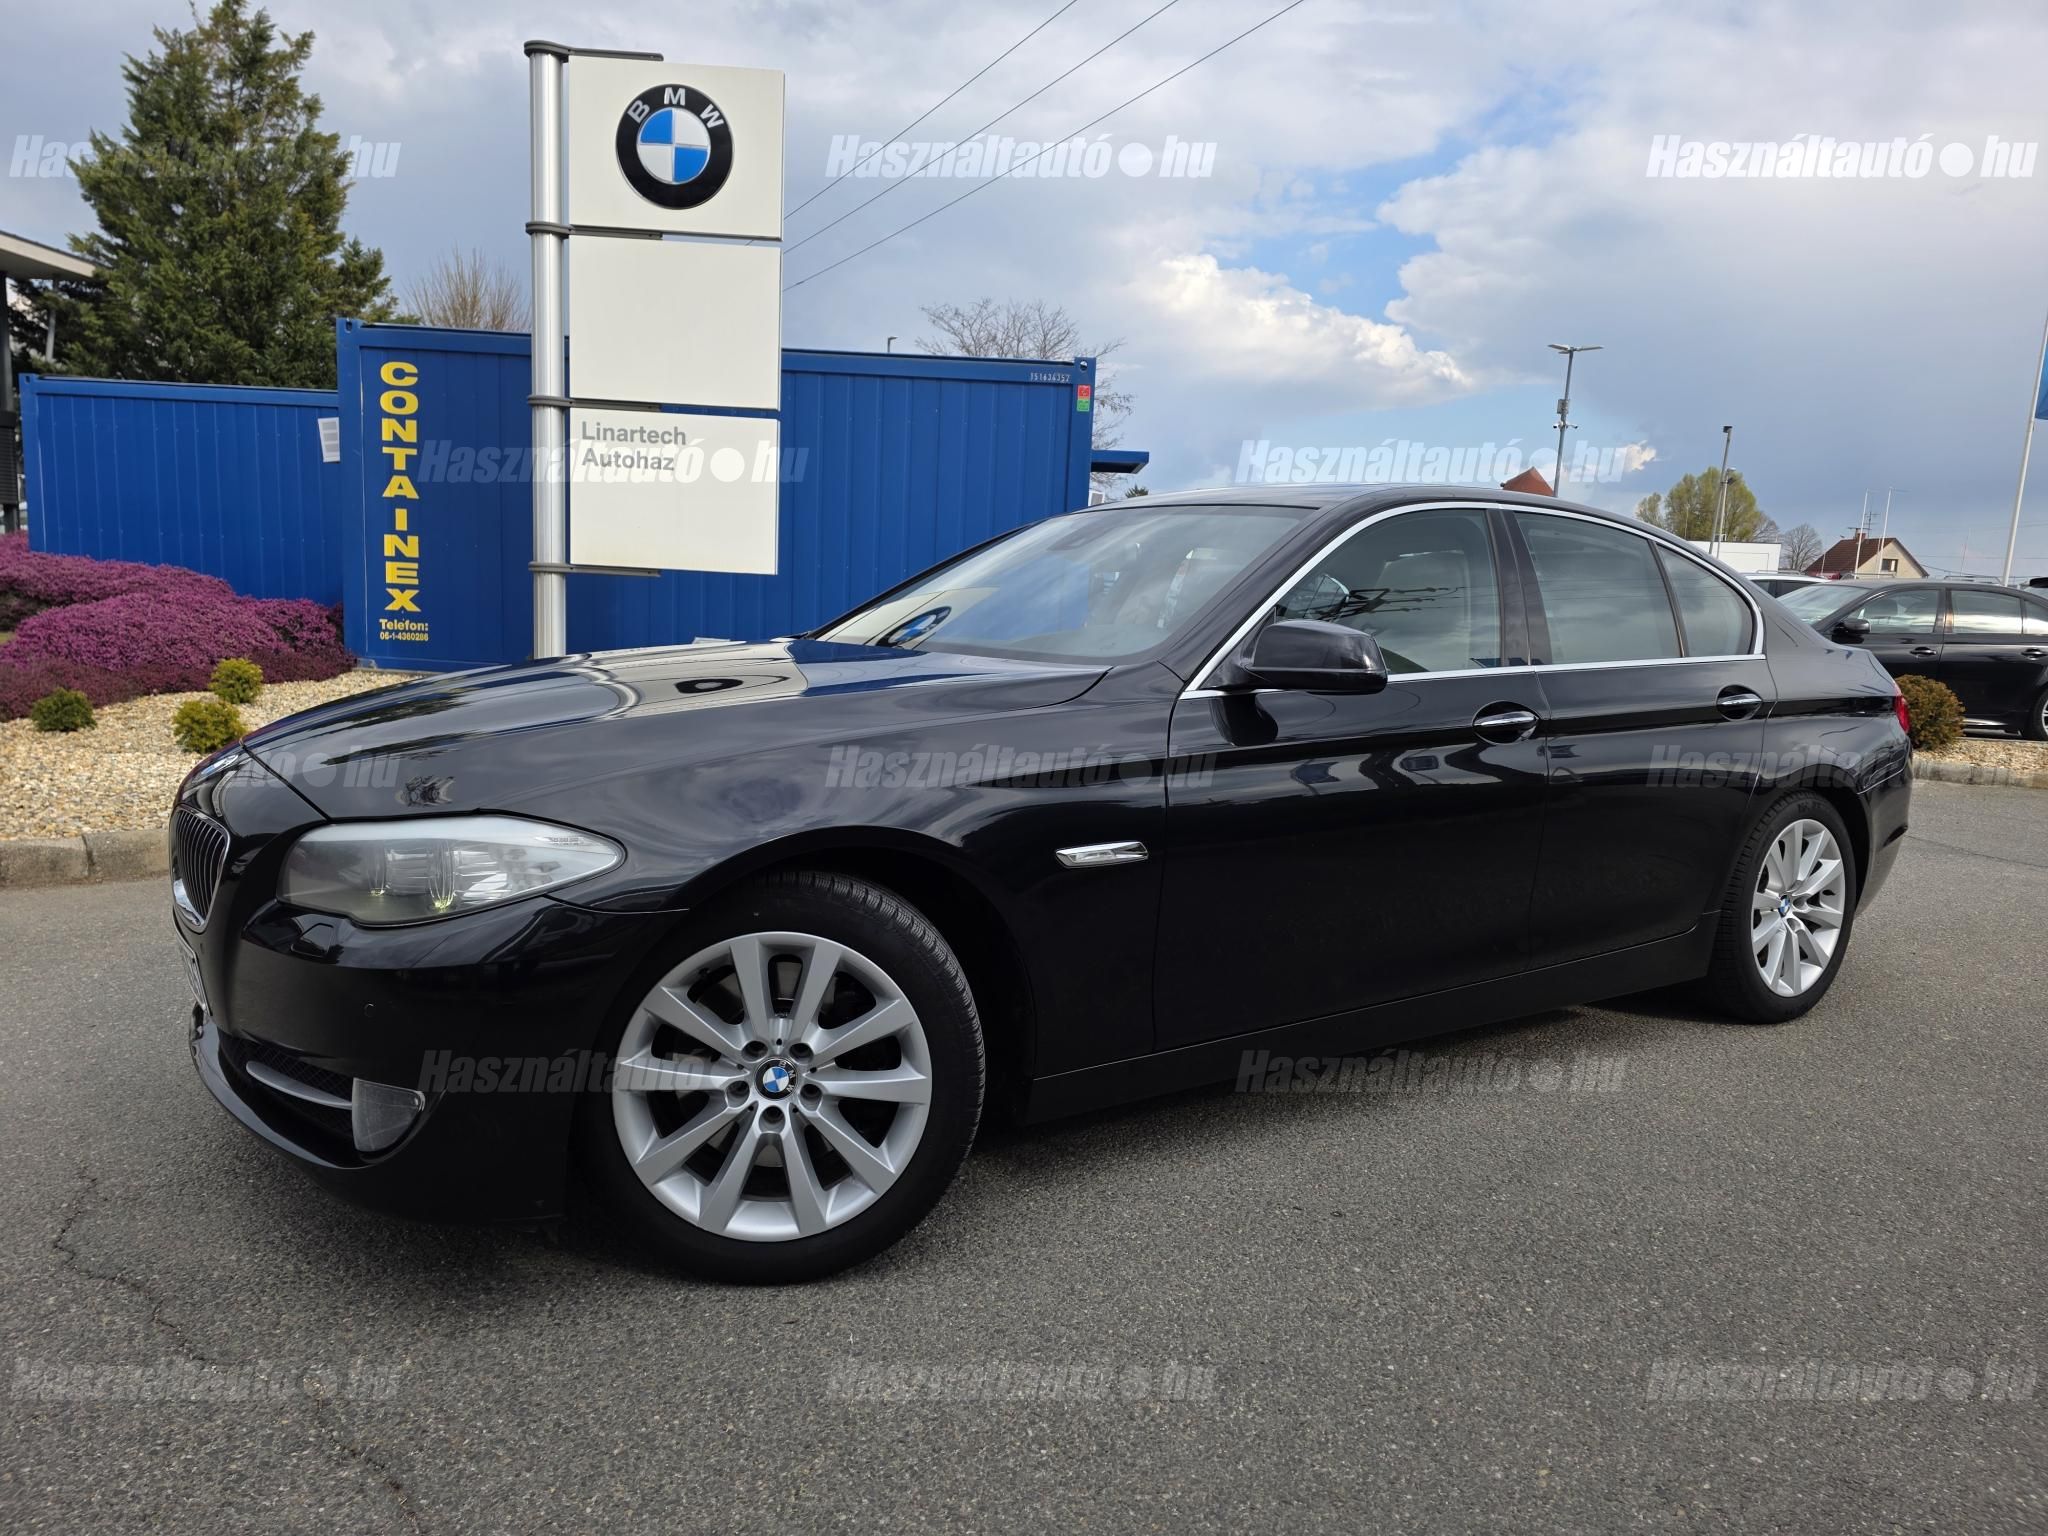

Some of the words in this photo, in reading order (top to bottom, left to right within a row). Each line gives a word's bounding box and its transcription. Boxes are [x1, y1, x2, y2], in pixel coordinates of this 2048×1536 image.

[627, 87, 724, 129] BMW
[582, 421, 687, 445] Linartech
[582, 447, 675, 471] Autohaz
[380, 361, 421, 612] CONTAINEX
[379, 618, 429, 631] Telefon:
